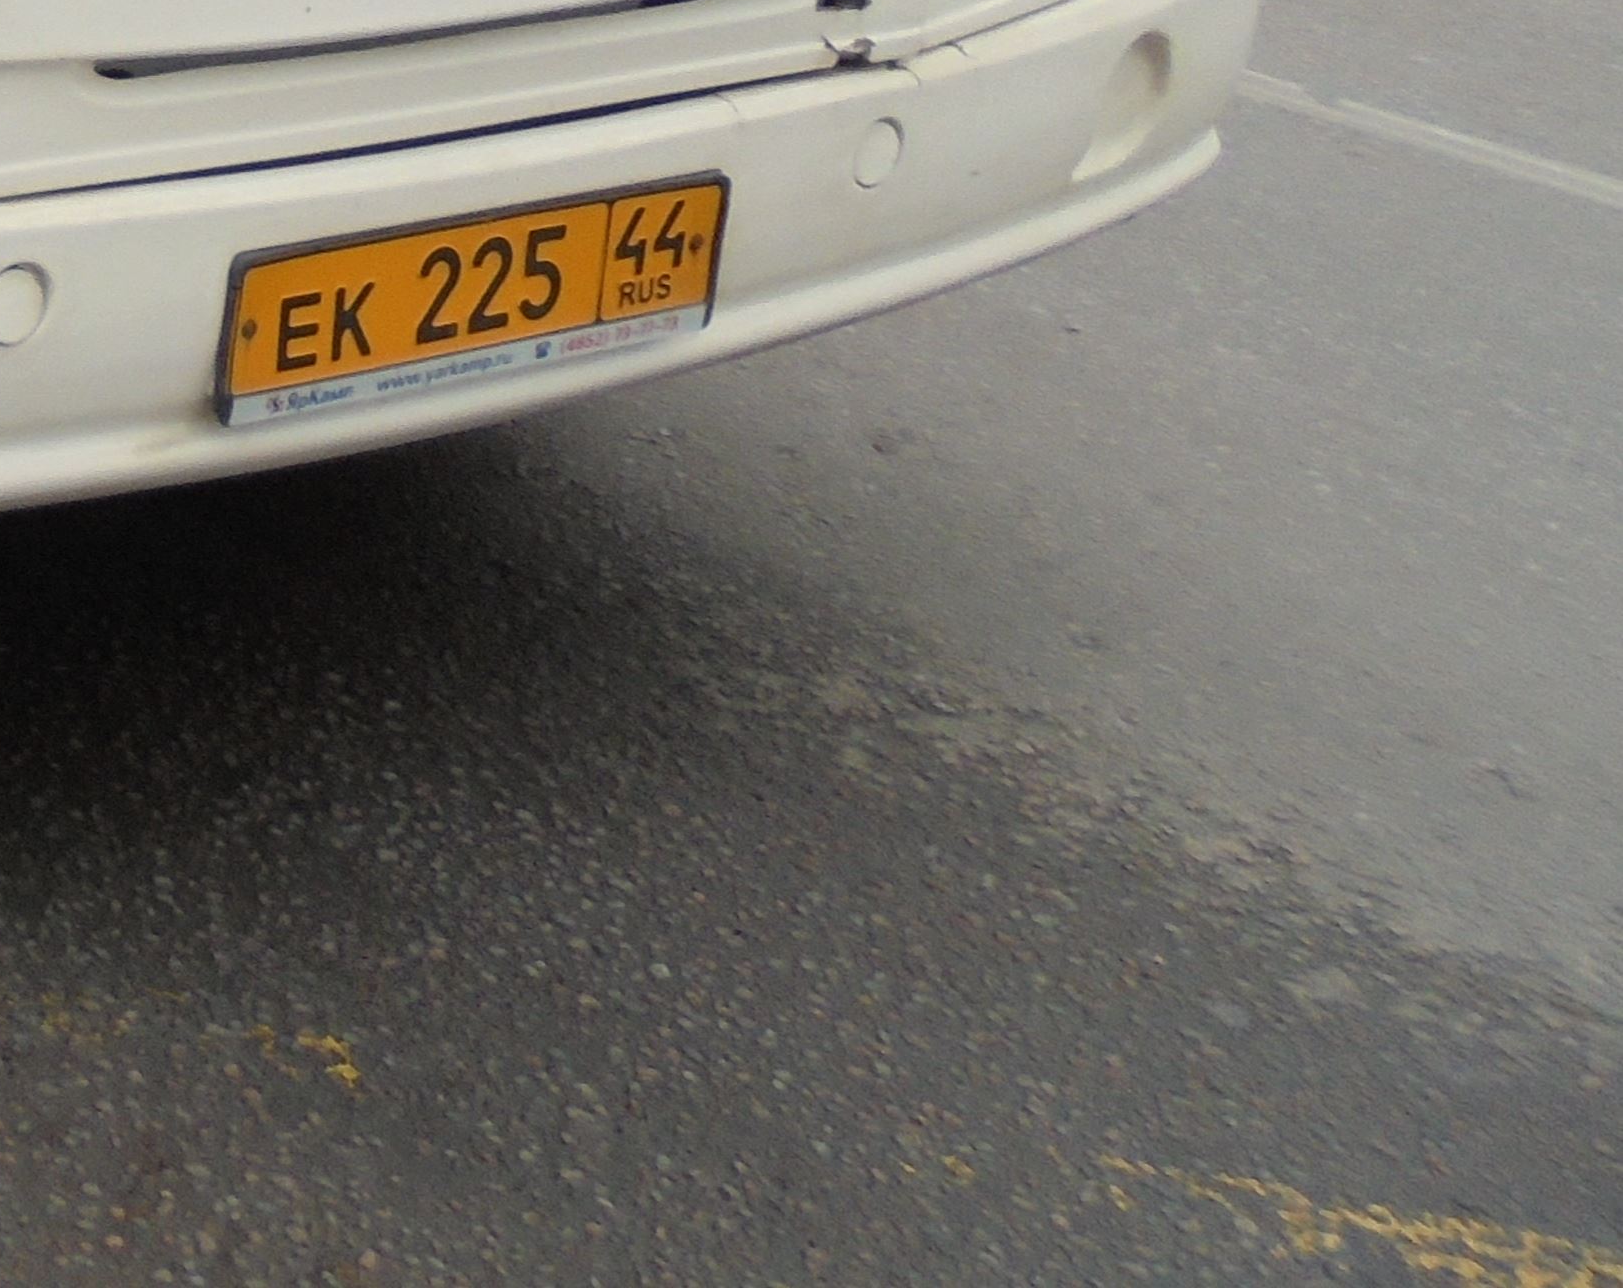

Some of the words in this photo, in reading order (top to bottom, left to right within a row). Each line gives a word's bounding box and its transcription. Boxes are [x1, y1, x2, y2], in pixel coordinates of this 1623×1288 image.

[415, 224, 568, 345] 225
[615, 199, 688, 276] 44
[617, 273, 672, 308] RUS
